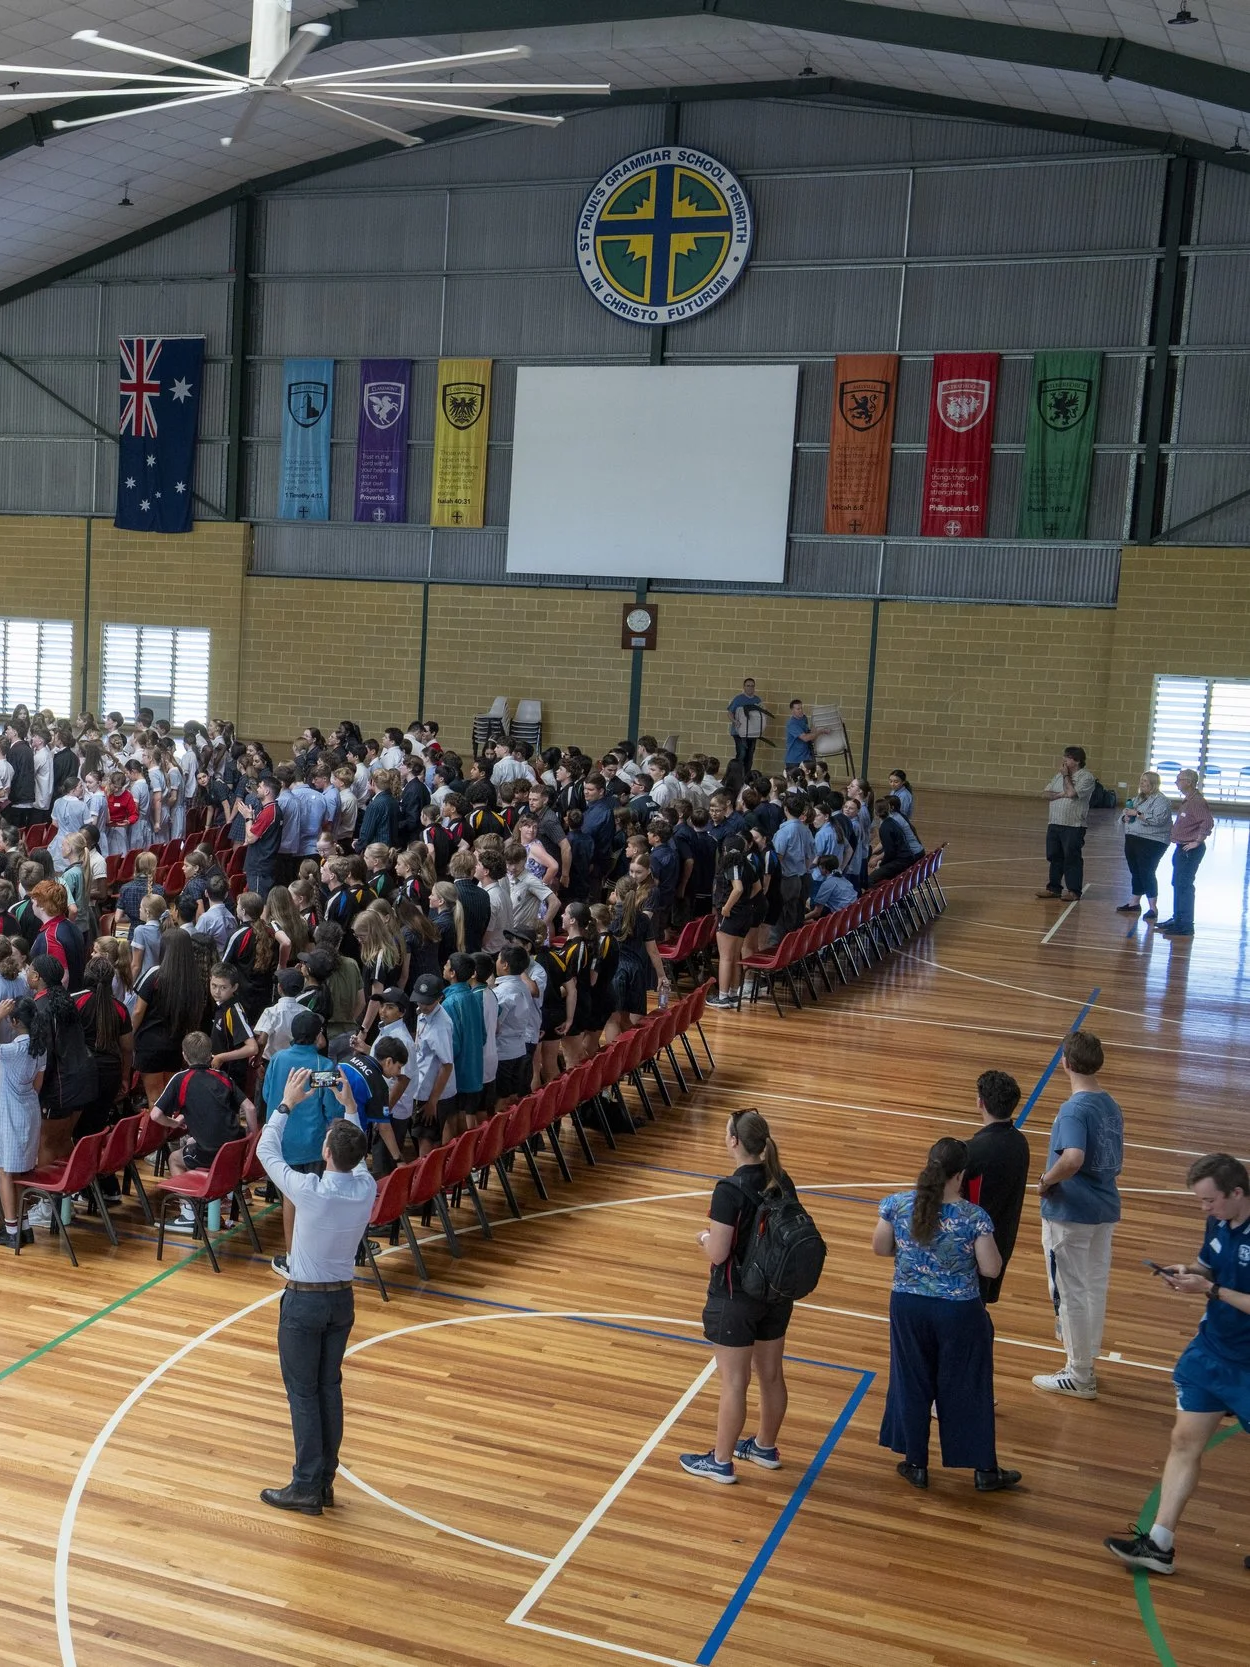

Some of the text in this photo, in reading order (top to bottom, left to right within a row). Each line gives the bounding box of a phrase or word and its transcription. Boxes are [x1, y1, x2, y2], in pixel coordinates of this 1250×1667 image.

[580, 150, 747, 251] ST PAUL'S GRAMMAR SCHOOL PENRITH
[591, 275, 729, 321] IN CHRISTO FUTURUM
[931, 474, 979, 482] things through
[931, 481, 965, 489] Christ who
[930, 489, 968, 497] strengthens
[929, 504, 965, 512] Philippians
[350, 1056, 373, 1076] MPAC
